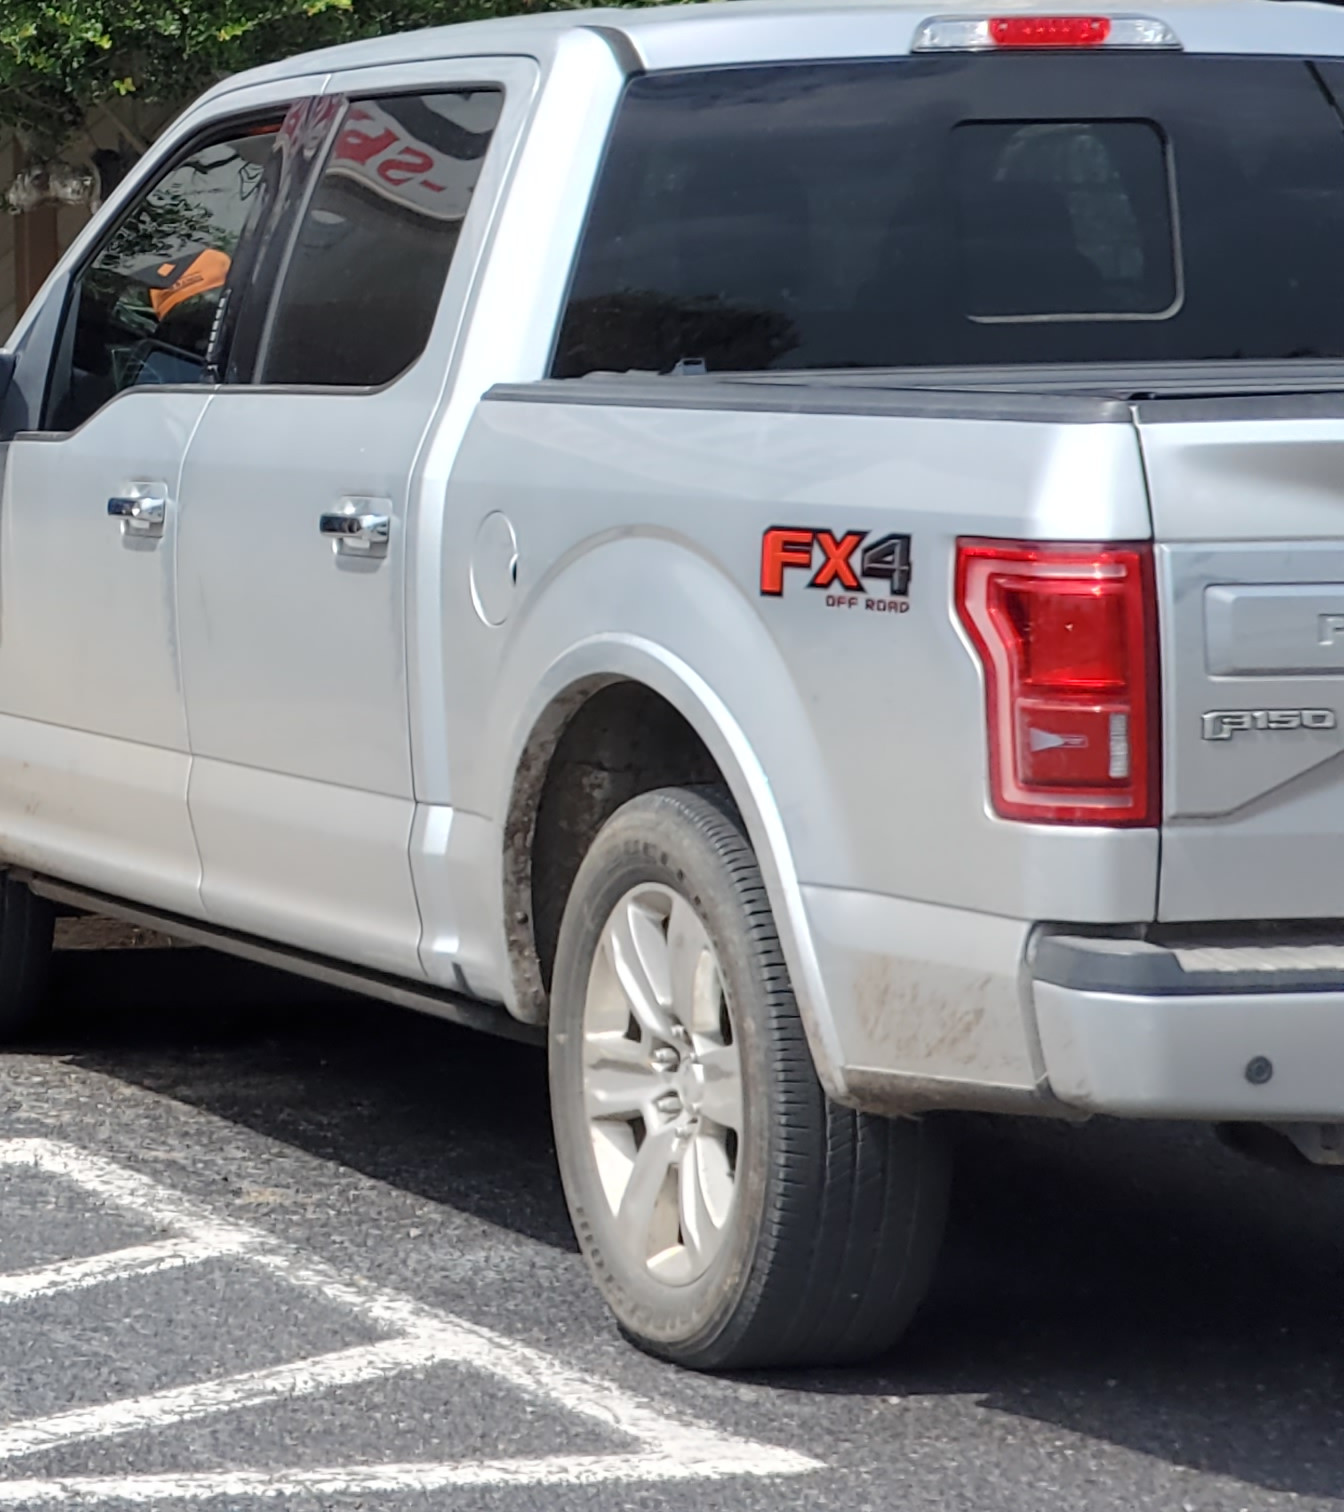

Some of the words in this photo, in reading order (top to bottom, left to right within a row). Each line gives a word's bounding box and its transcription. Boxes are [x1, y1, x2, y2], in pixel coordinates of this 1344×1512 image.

[759, 525, 912, 598] FX4
[825, 594, 859, 609] OFF
[865, 598, 910, 613] ROAD
